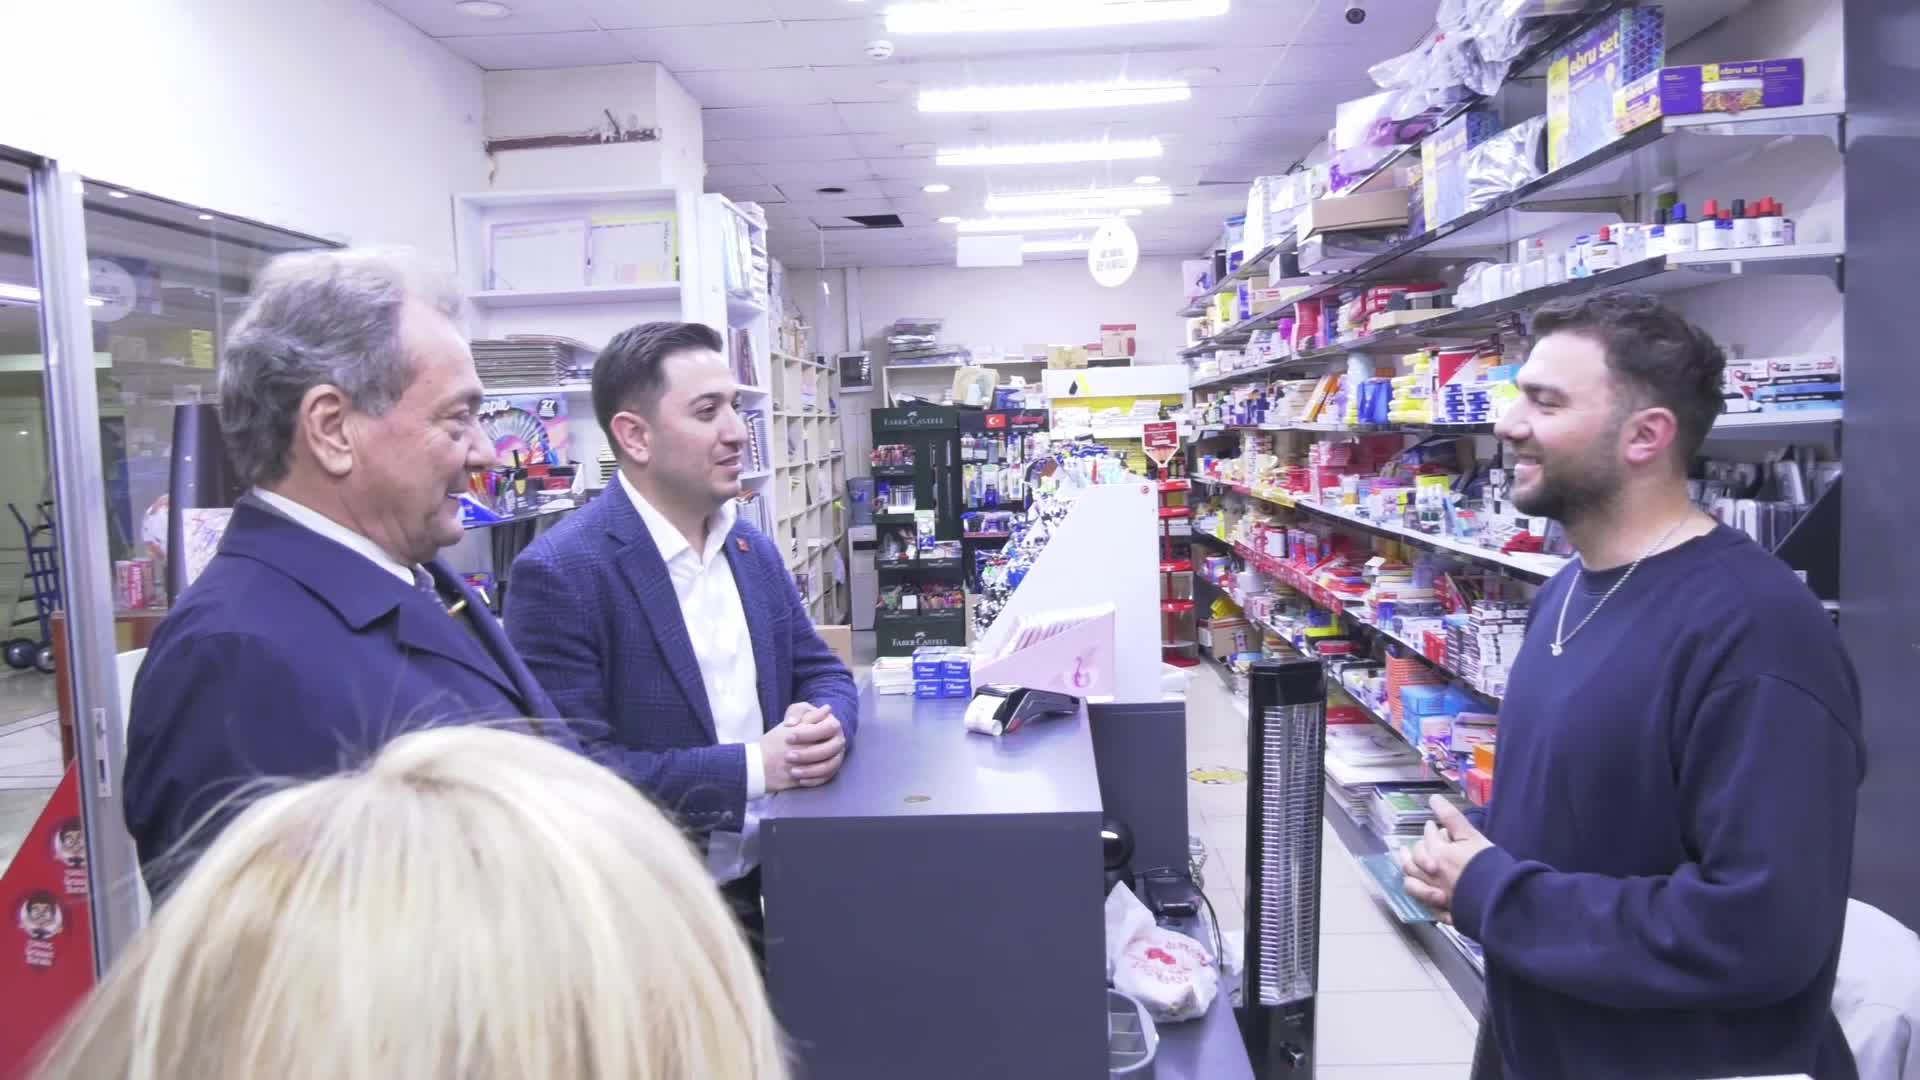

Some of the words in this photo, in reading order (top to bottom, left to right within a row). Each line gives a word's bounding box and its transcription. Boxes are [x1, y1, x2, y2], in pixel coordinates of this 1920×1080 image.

[1569, 47, 1597, 77] ebru
[1599, 29, 1620, 58] set
[541, 400, 555, 409] 27
